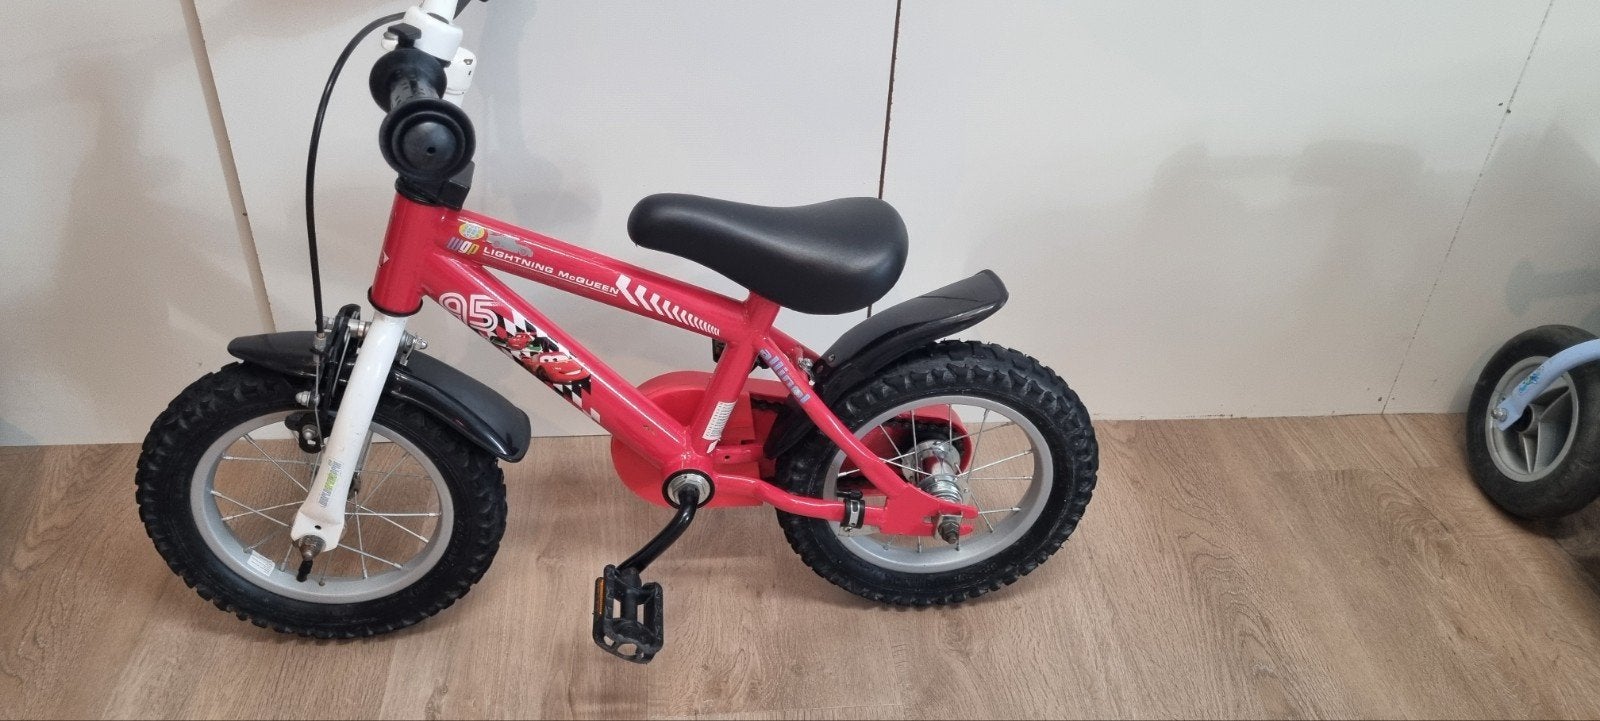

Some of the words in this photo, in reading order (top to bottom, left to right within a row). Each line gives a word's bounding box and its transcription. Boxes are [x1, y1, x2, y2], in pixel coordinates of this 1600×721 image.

[483, 246, 554, 274] LIGHTNING
[558, 270, 620, 295] McQUEEN
[438, 292, 499, 333] 95
